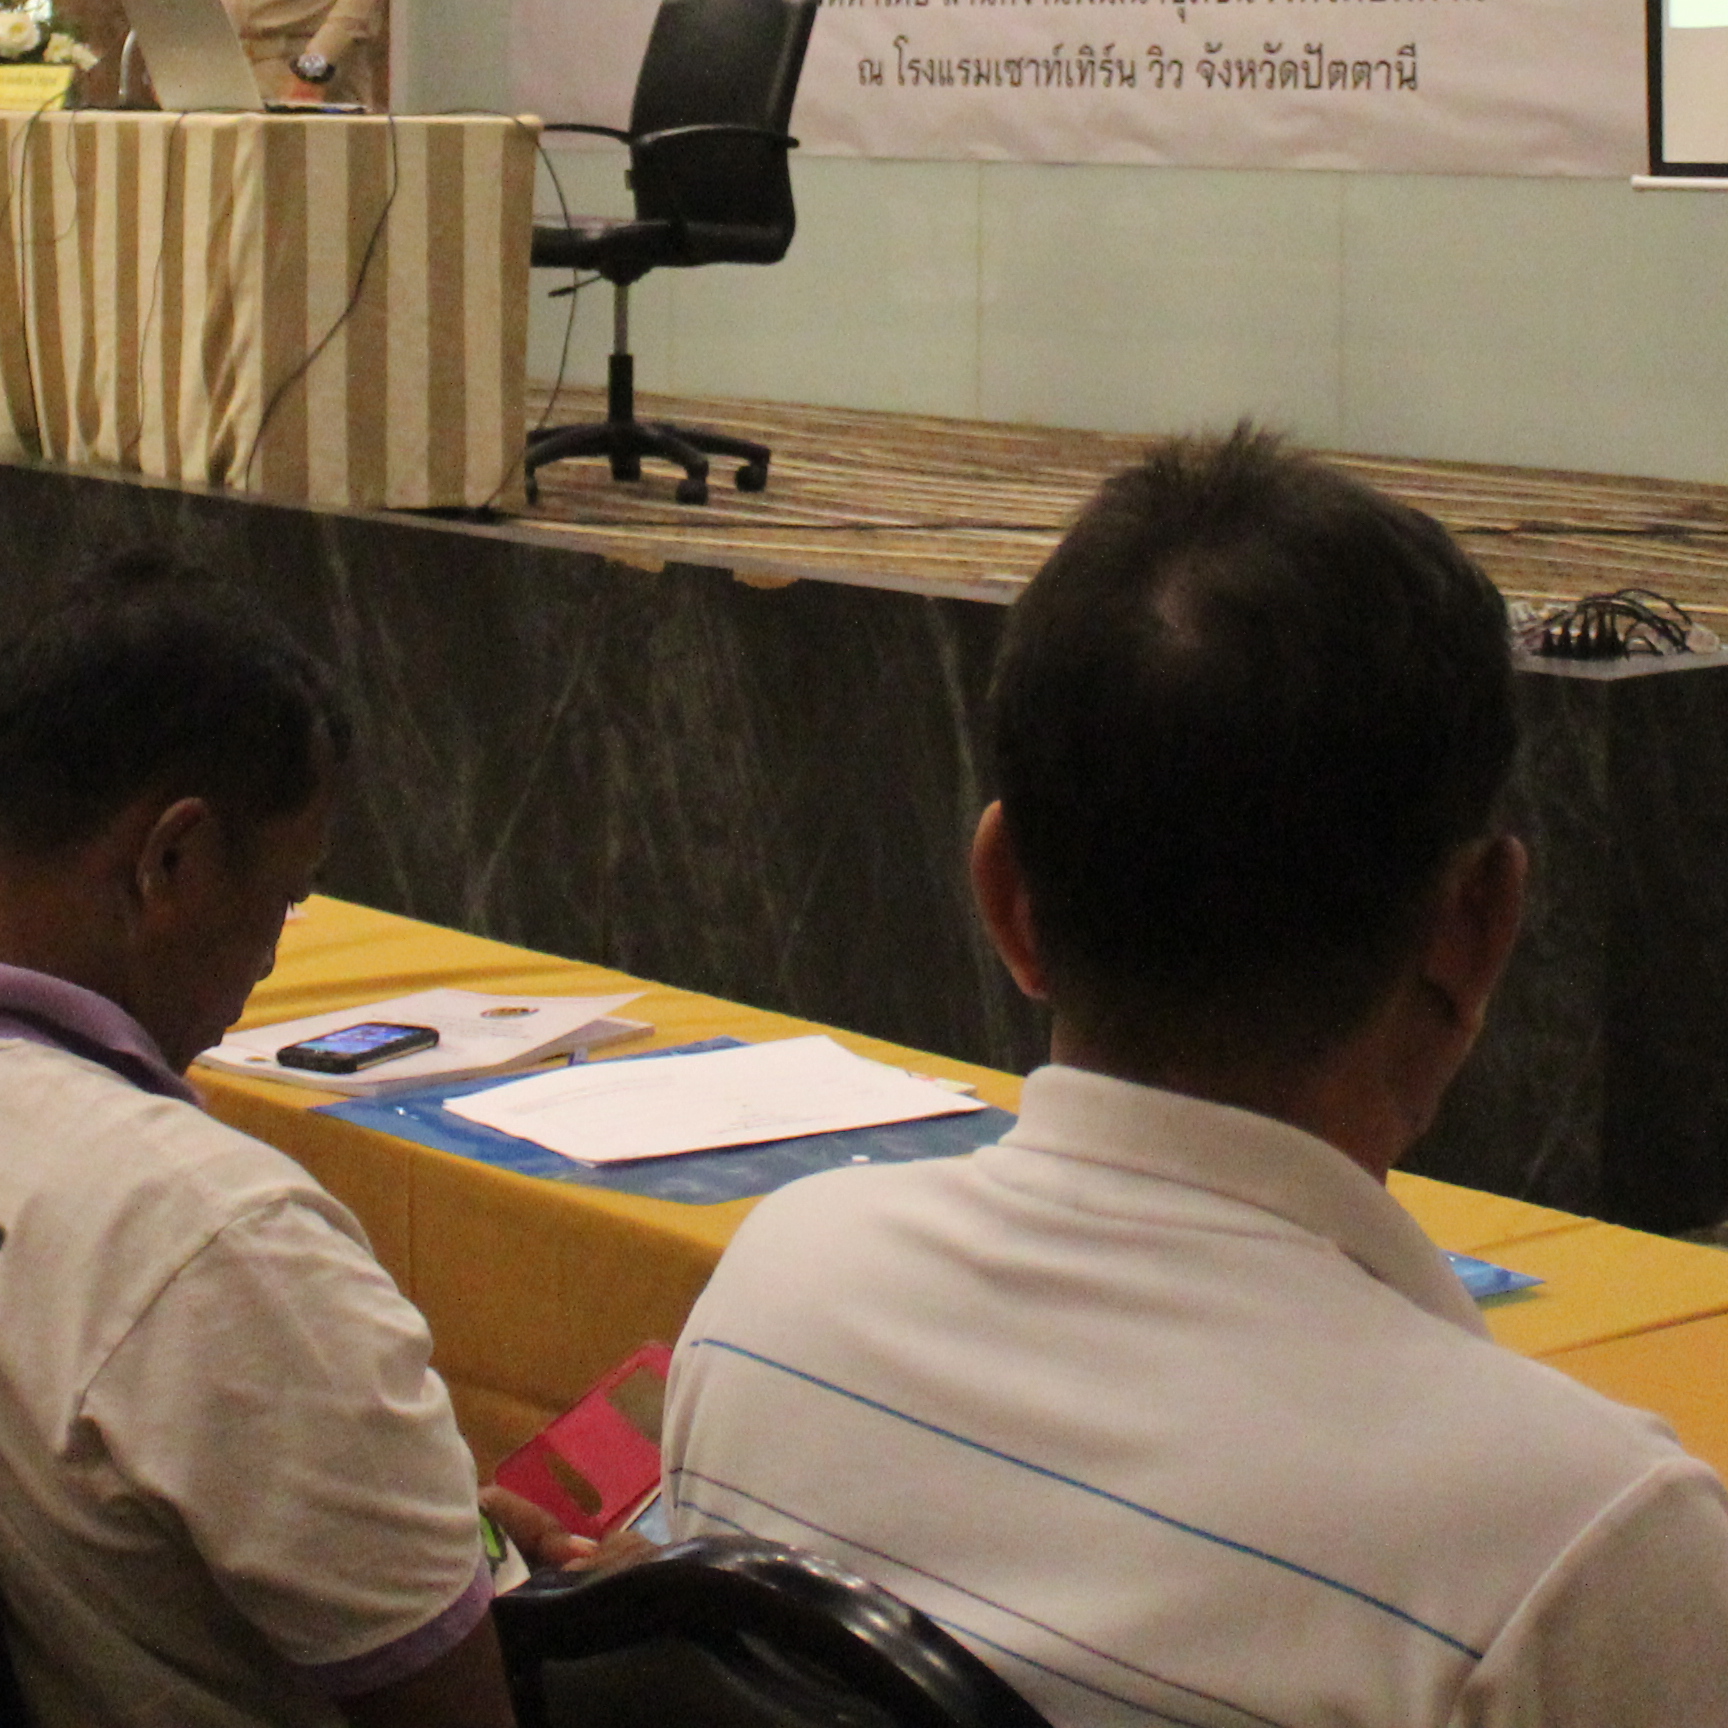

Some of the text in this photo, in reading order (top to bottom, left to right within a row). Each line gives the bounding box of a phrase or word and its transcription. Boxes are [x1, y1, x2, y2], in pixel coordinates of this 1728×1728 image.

[857, 34, 1419, 92] ณ โรงแรมเซาท์เทิร์น วิว จังหวัดปัตตานี
